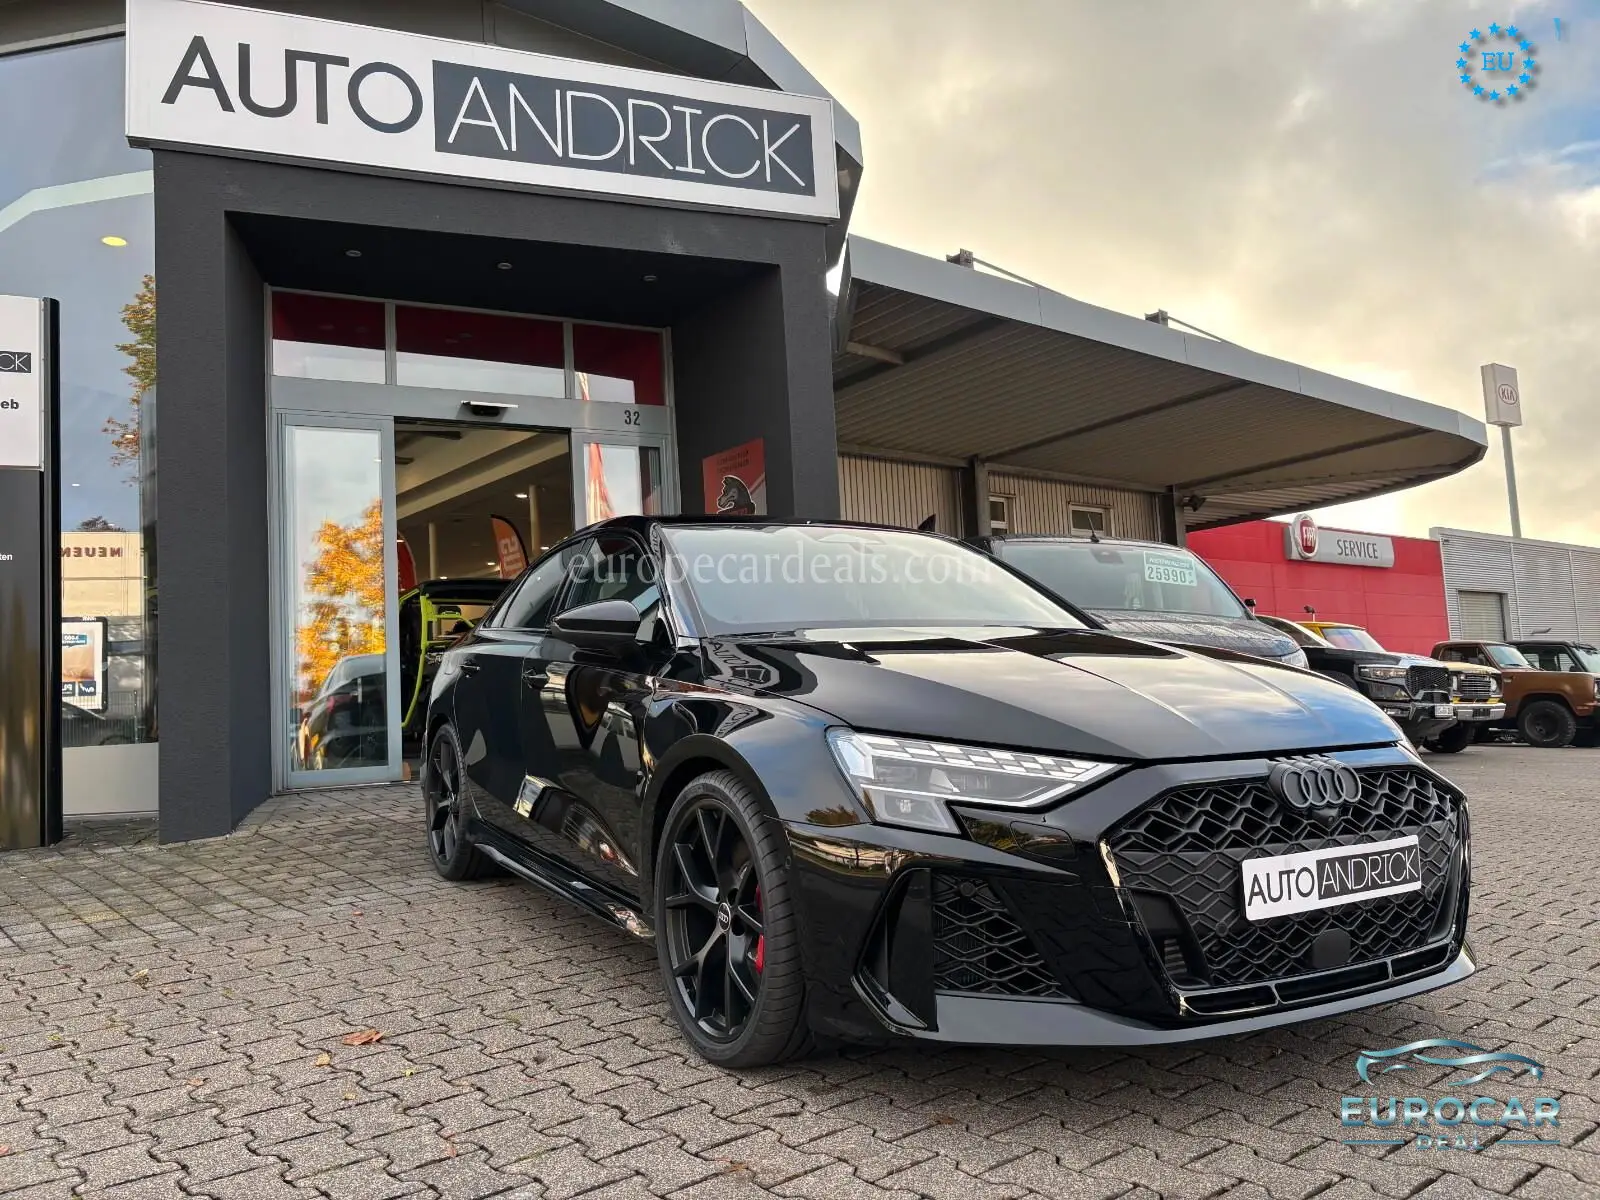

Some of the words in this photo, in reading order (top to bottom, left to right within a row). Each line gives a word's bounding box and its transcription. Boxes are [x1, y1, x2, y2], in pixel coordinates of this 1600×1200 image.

[162, 35, 423, 134] AUTO
[448, 76, 806, 187] ANDRICK
[1501, 387, 1515, 402] KIA
[624, 409, 641, 426] 32
[1336, 539, 1379, 560] SERVICE
[1147, 566, 1187, 584] 25990
[1247, 866, 1315, 907] AUTO
[1321, 848, 1418, 895] ANDRICK
